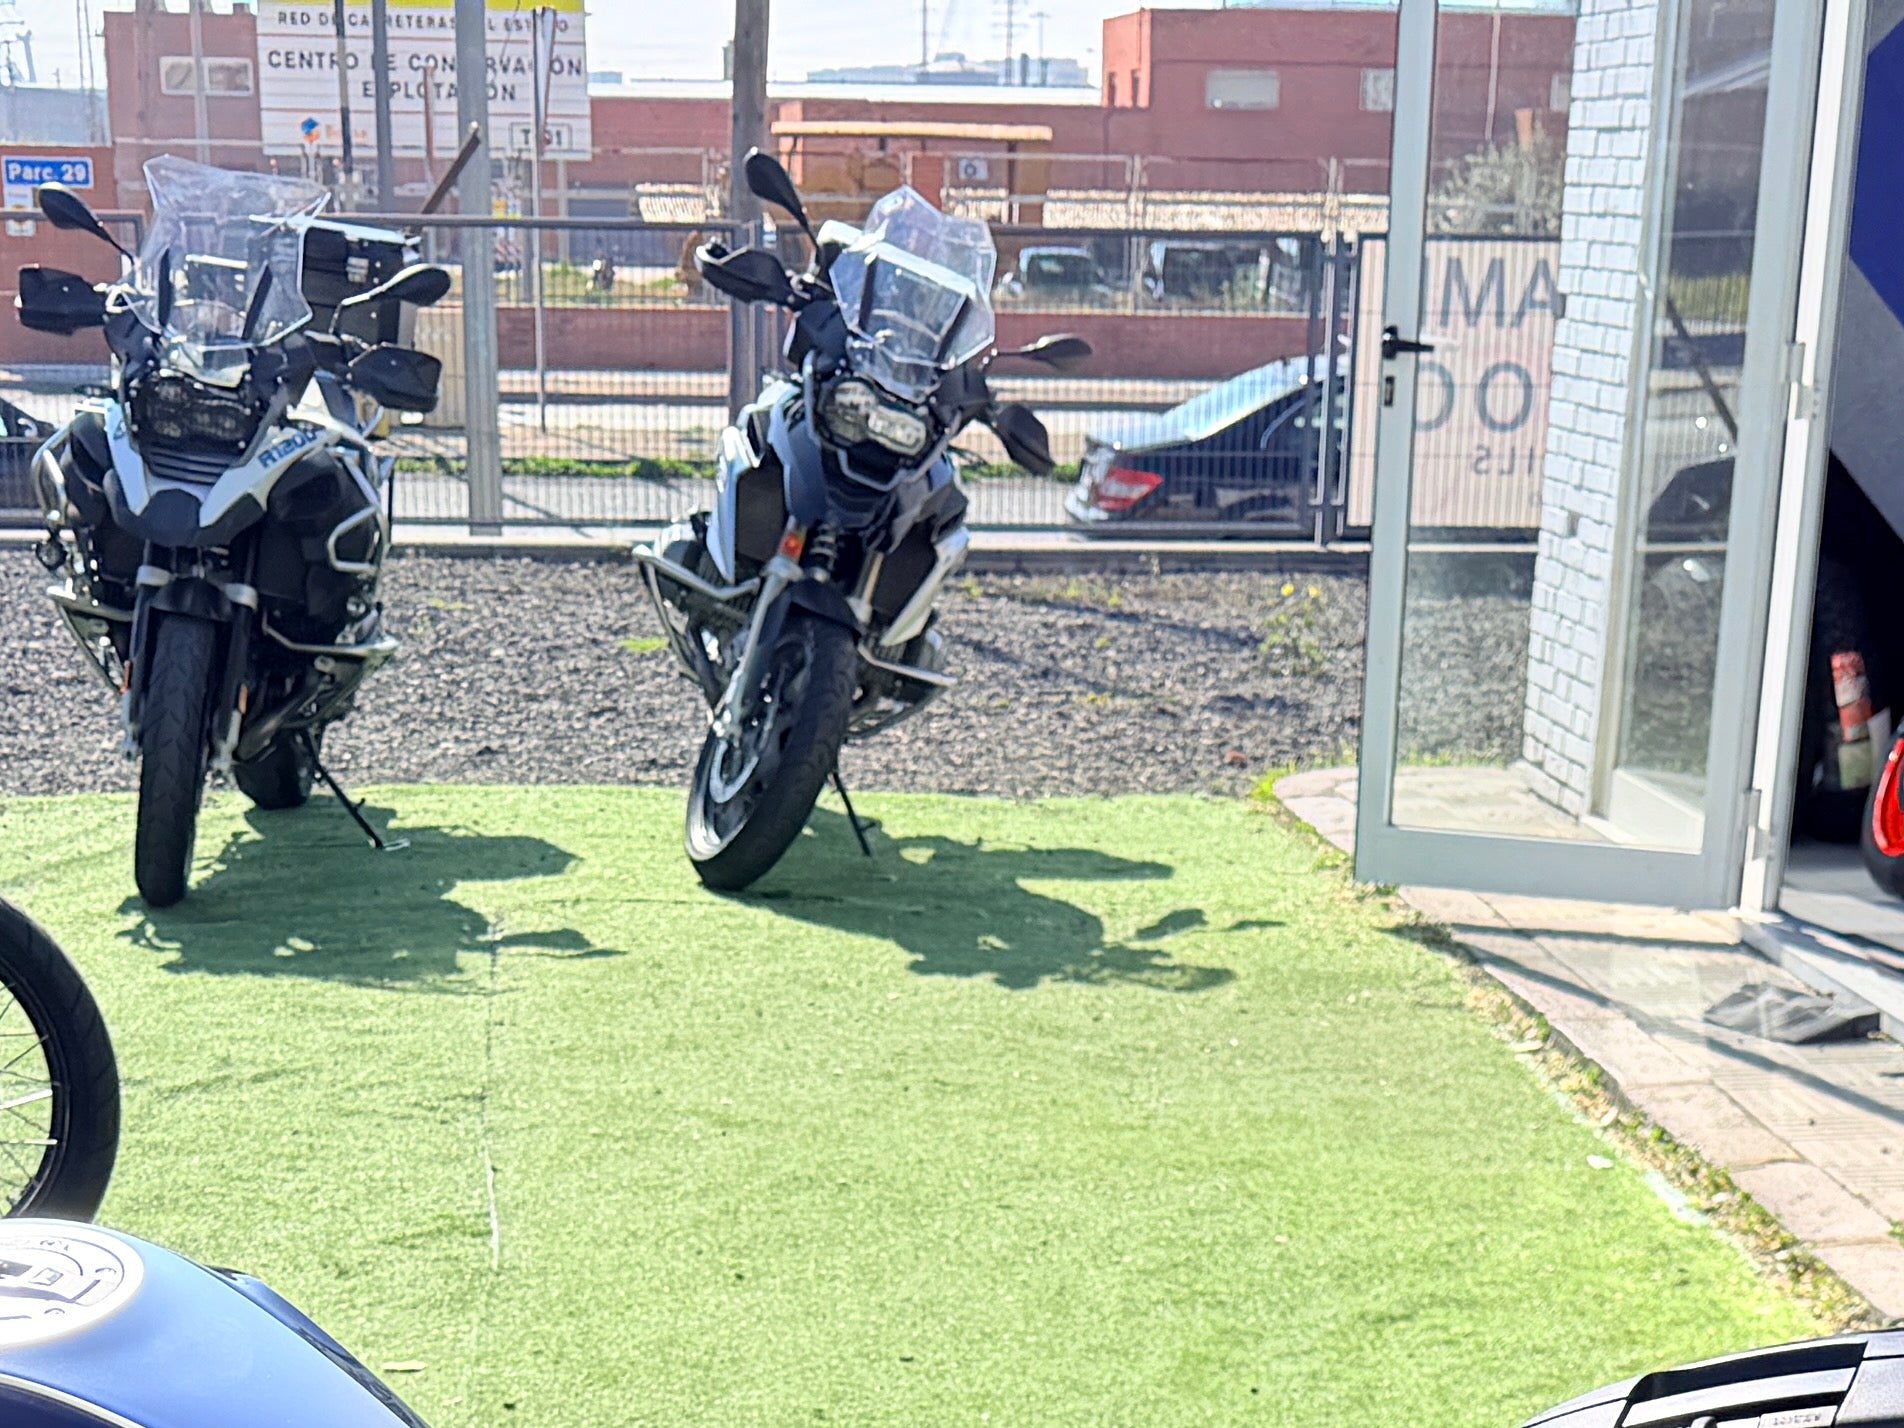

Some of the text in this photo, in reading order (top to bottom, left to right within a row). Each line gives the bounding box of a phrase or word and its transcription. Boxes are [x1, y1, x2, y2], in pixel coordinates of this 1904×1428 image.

[278, 12, 310, 25] RED
[319, 13, 336, 26] D
[348, 13, 455, 30] CARETERAS
[60, 163, 87, 182] 29
